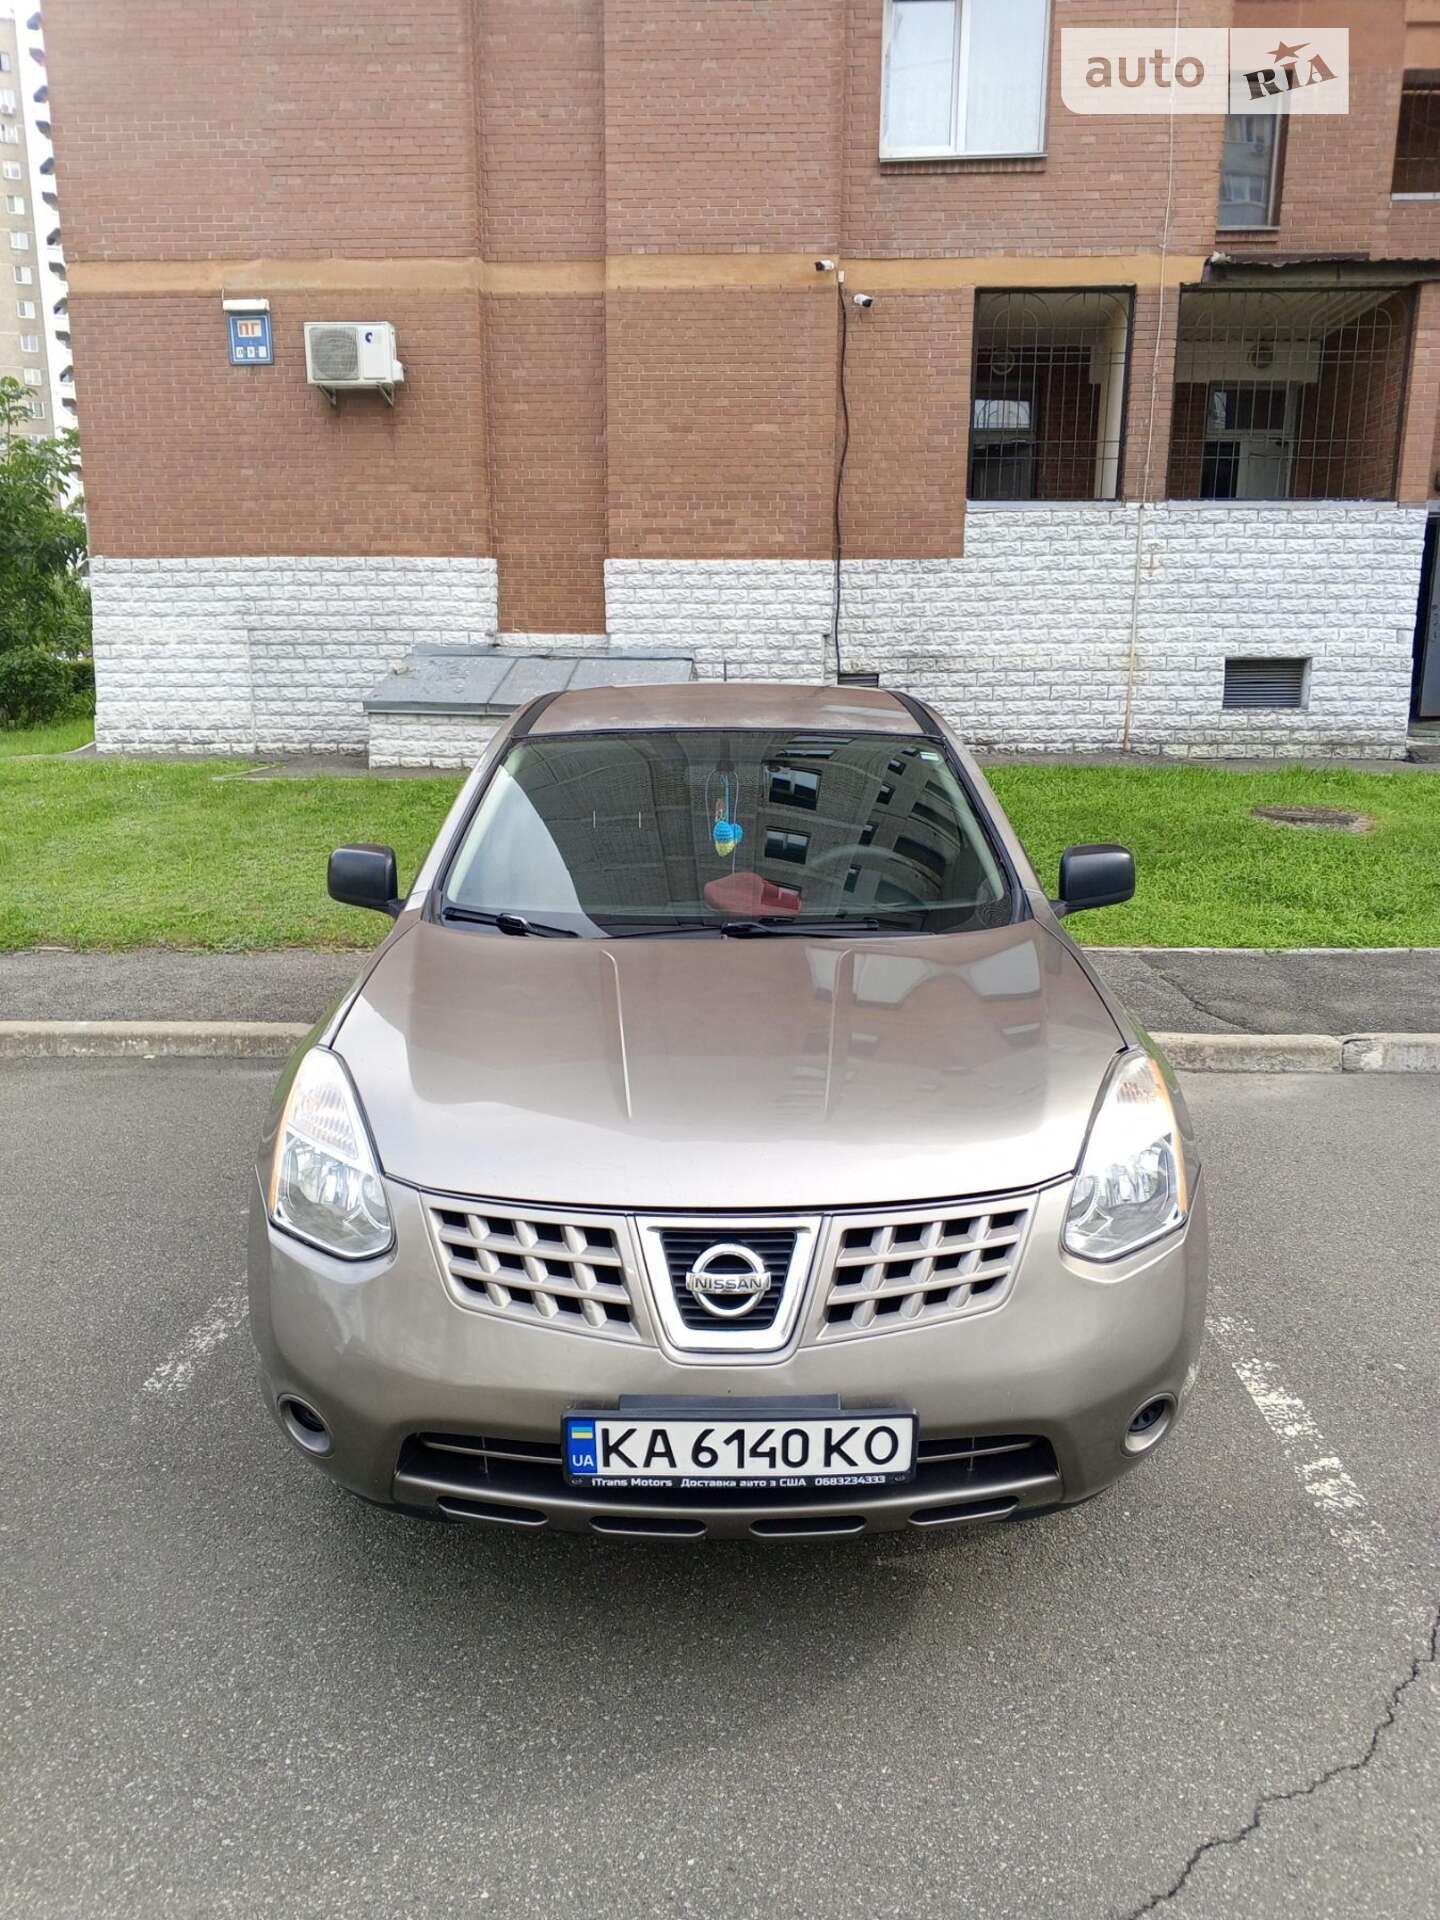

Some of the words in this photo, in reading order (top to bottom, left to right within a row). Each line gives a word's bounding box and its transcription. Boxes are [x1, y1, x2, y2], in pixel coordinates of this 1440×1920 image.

[694, 1278, 762, 1290] NISSAN
[572, 1455, 594, 1467] UA
[631, 1478, 673, 1488] Motors
[680, 1478, 736, 1488] Доставка
[779, 1478, 806, 1487] США
